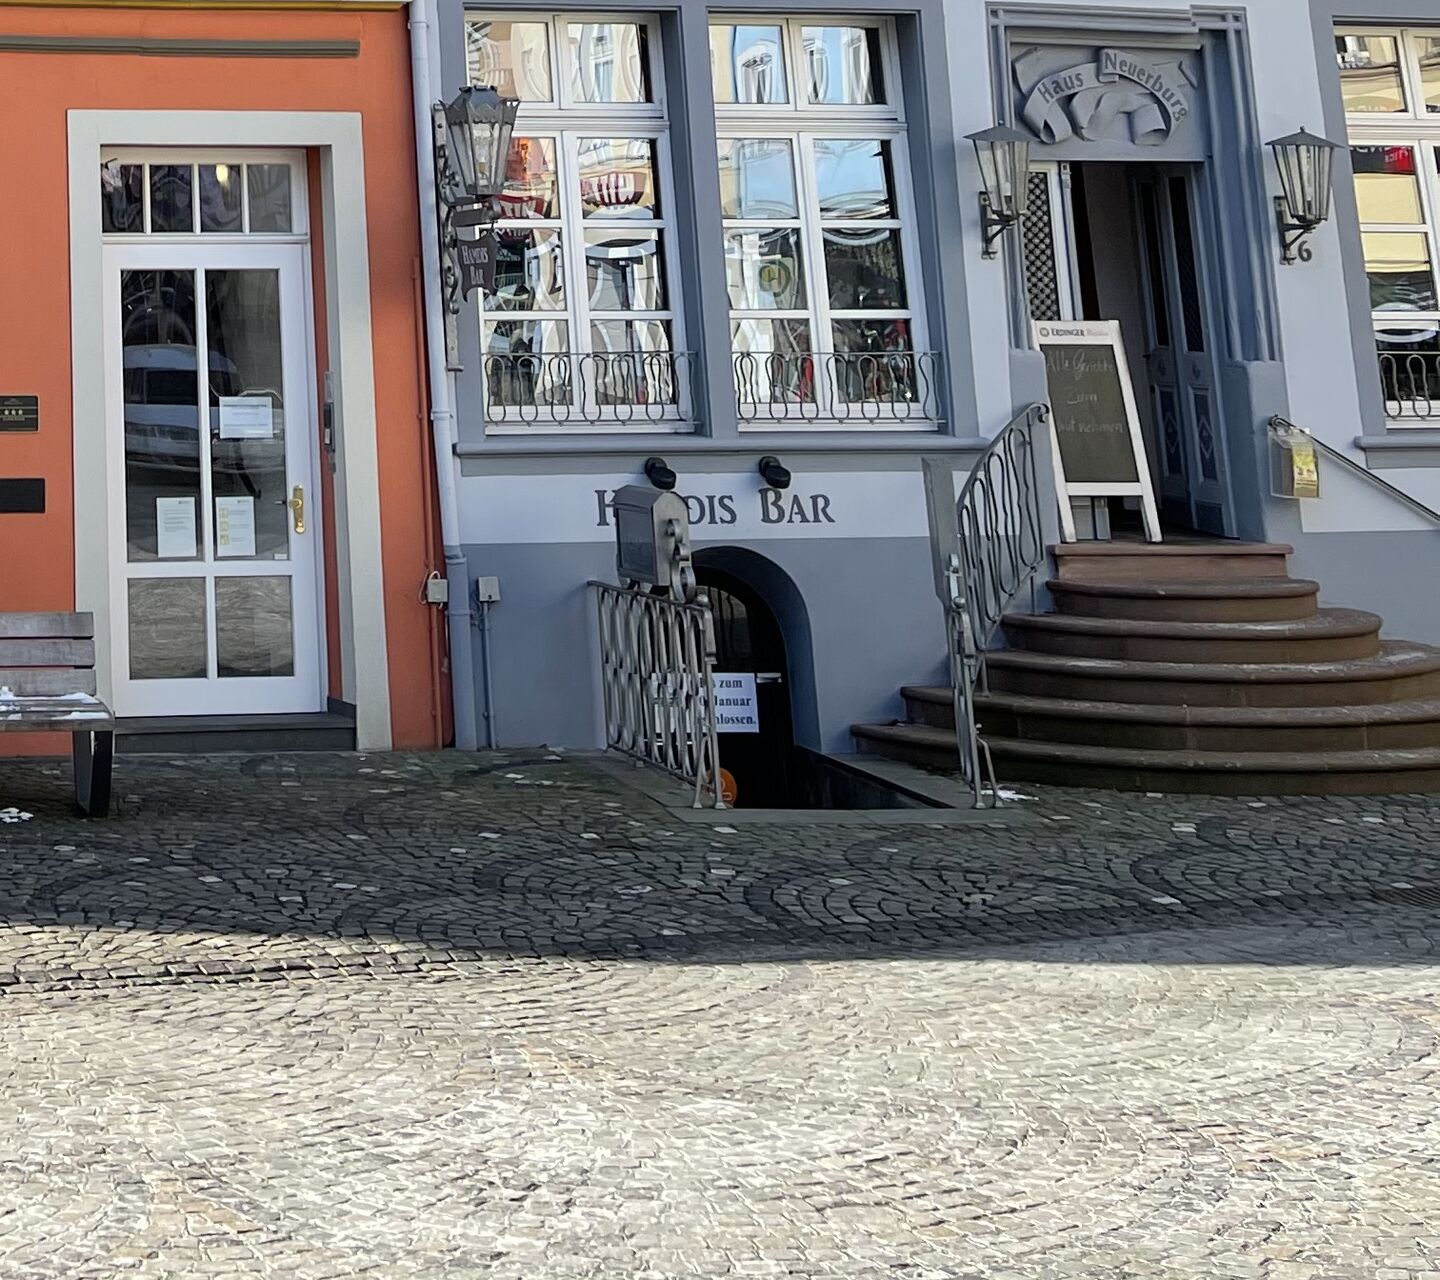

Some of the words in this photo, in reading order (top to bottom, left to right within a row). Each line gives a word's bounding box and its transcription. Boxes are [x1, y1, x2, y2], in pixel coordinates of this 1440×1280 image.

[1037, 72, 1083, 104] Haus
[1103, 51, 1188, 122] Neuerburg
[1297, 240, 1312, 262] 6
[759, 487, 836, 524] BAR
[719, 679, 743, 689] zum
